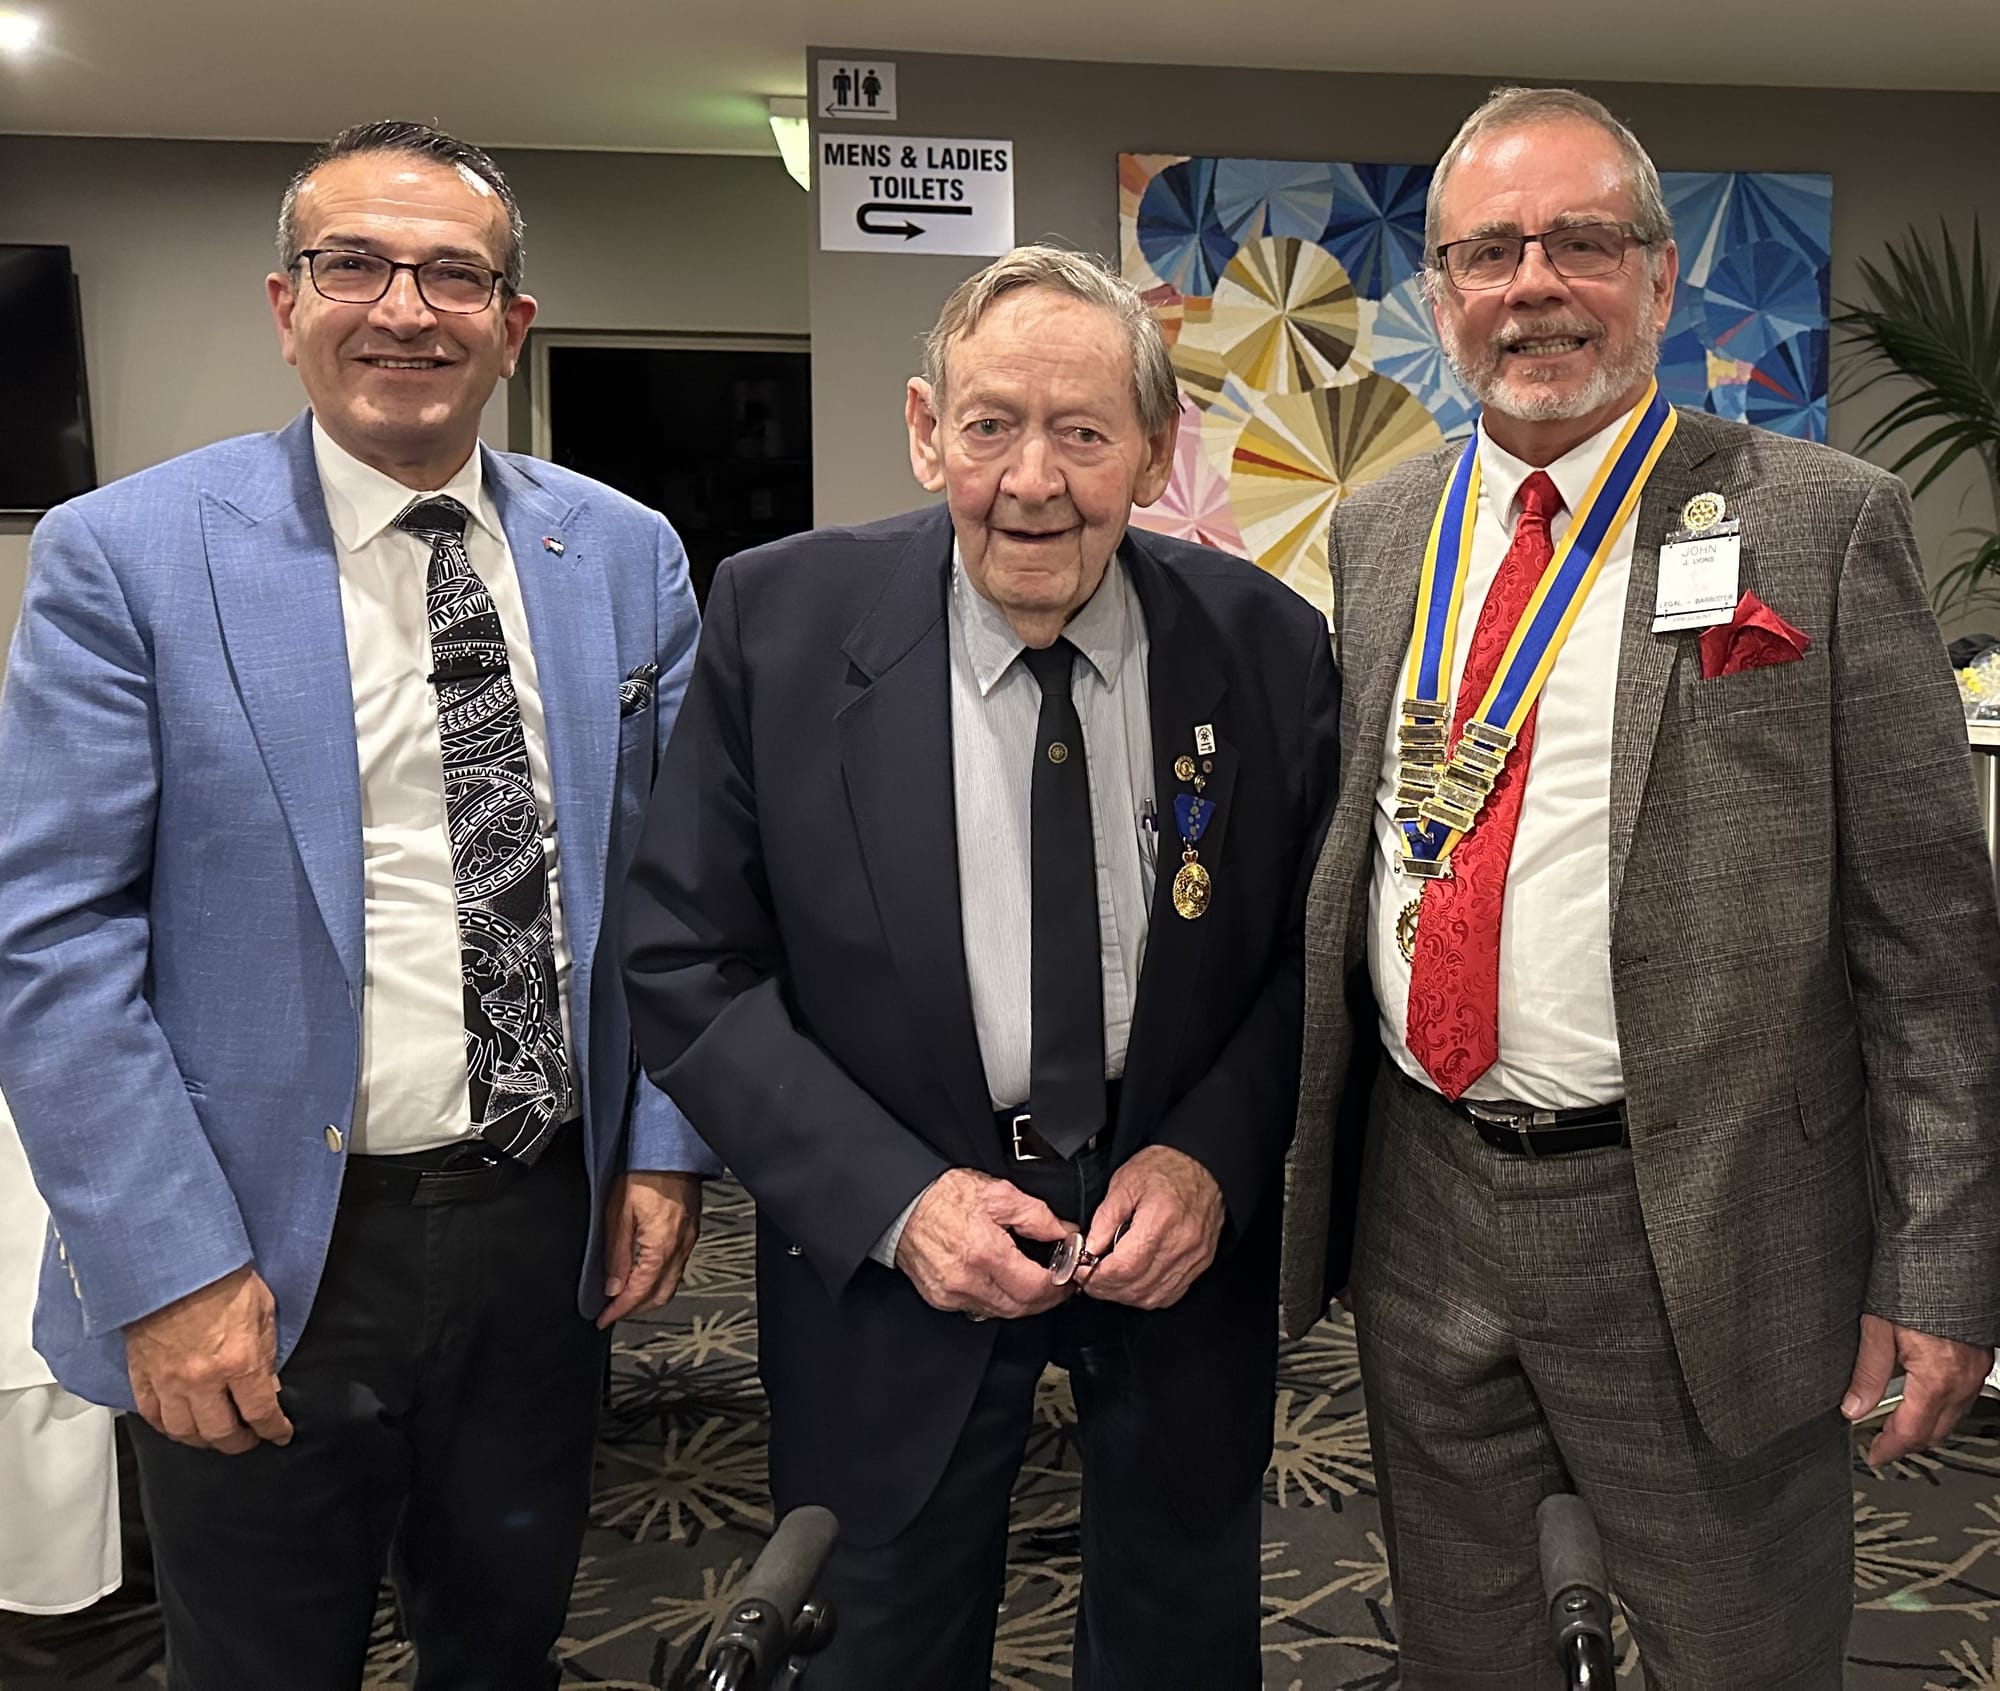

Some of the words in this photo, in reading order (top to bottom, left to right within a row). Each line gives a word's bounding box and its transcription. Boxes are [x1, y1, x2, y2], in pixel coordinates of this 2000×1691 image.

[824, 143, 891, 167] MENS
[900, 146, 917, 169] &
[927, 147, 1007, 172] LADIES
[869, 176, 964, 201] TOILETS
[1681, 545, 1717, 557] JOHN
[1692, 556, 1714, 565] LYONS
[1659, 600, 1683, 609] LEGAL
[1695, 594, 1733, 605] BARRISTER
